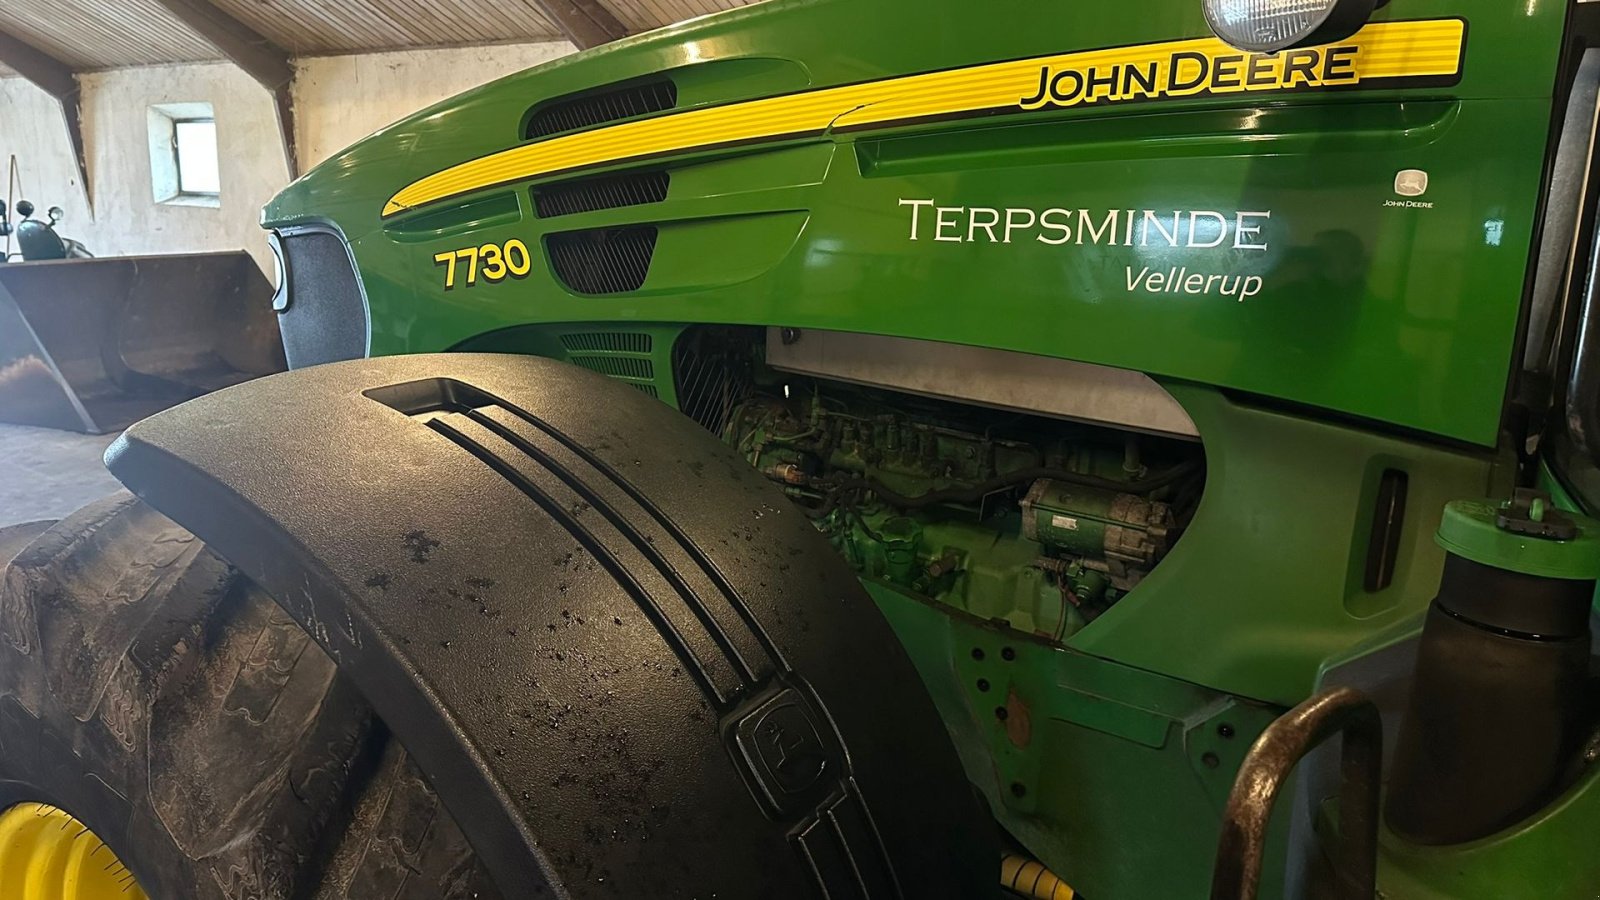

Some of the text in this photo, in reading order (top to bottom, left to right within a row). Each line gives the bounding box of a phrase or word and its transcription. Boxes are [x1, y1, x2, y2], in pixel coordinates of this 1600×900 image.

[1020, 45, 1361, 107] JOHN DEERE
[898, 197, 1271, 251] TERPSMINDE
[1382, 200, 1405, 208] JOHN
[434, 238, 531, 290] 7730
[1125, 266, 1263, 302] Vellerup
